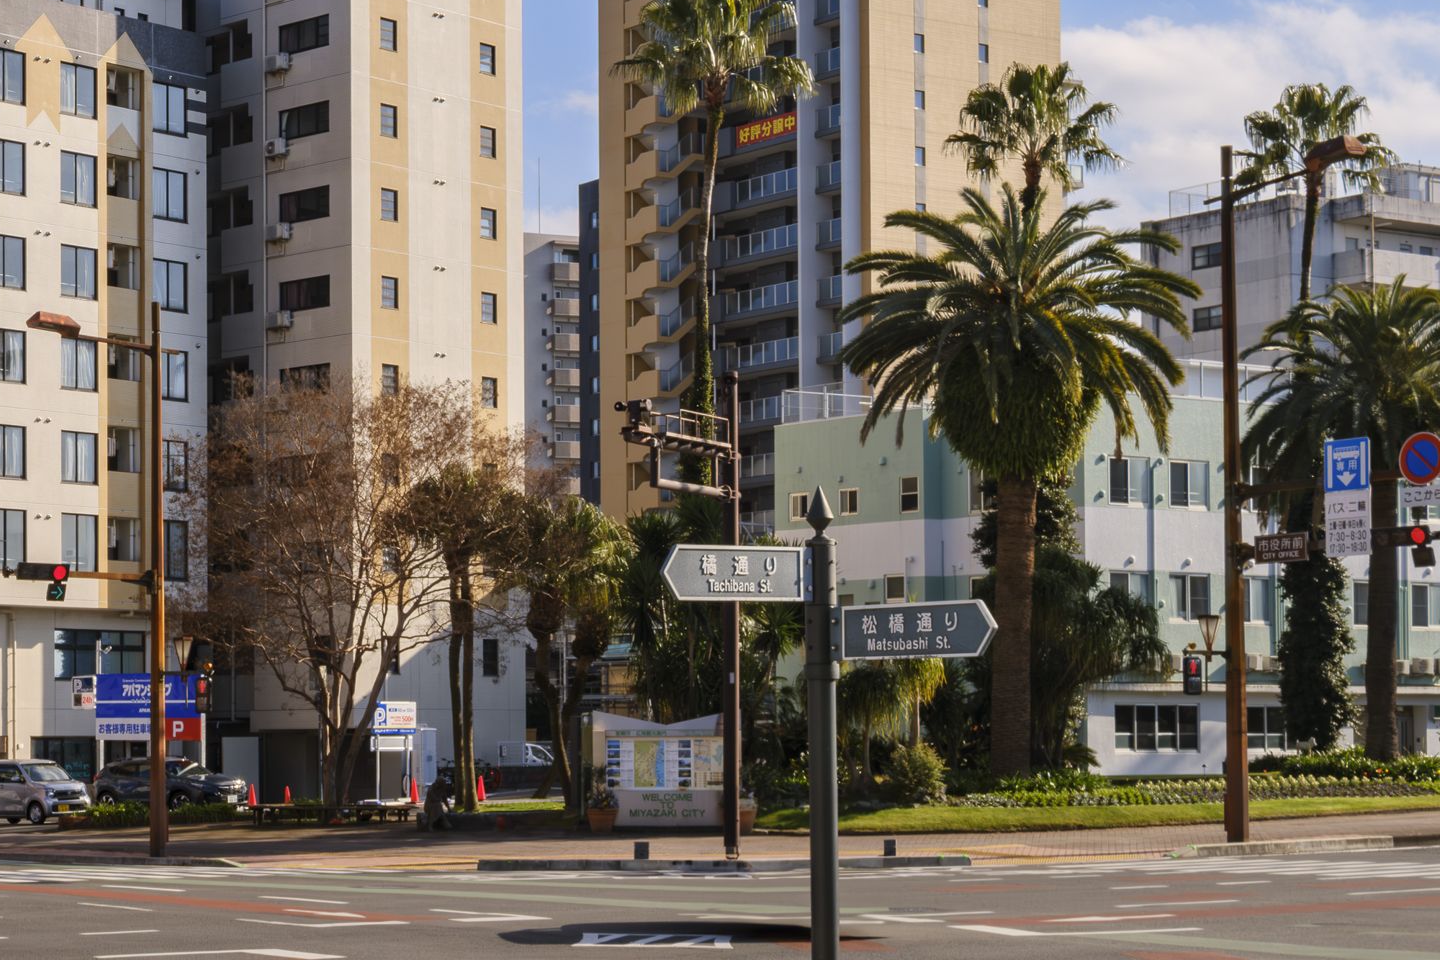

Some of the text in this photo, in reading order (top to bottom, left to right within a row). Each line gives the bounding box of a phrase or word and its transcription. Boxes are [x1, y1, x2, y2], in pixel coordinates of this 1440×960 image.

[739, 115, 796, 144] 好評分譲中
[1336, 459, 1358, 471] 専用
[1258, 536, 1304, 551] 市役所前
[1262, 550, 1300, 560] CITY OFFICE
[701, 554, 777, 576] 橘通り
[708, 578, 773, 593] Tachibana St.
[861, 611, 958, 635] 松橋通り
[867, 636, 951, 652] Matsubashi St.
[641, 792, 693, 802] WELCOME
[629, 808, 705, 818] MIYAZAKI CITY
